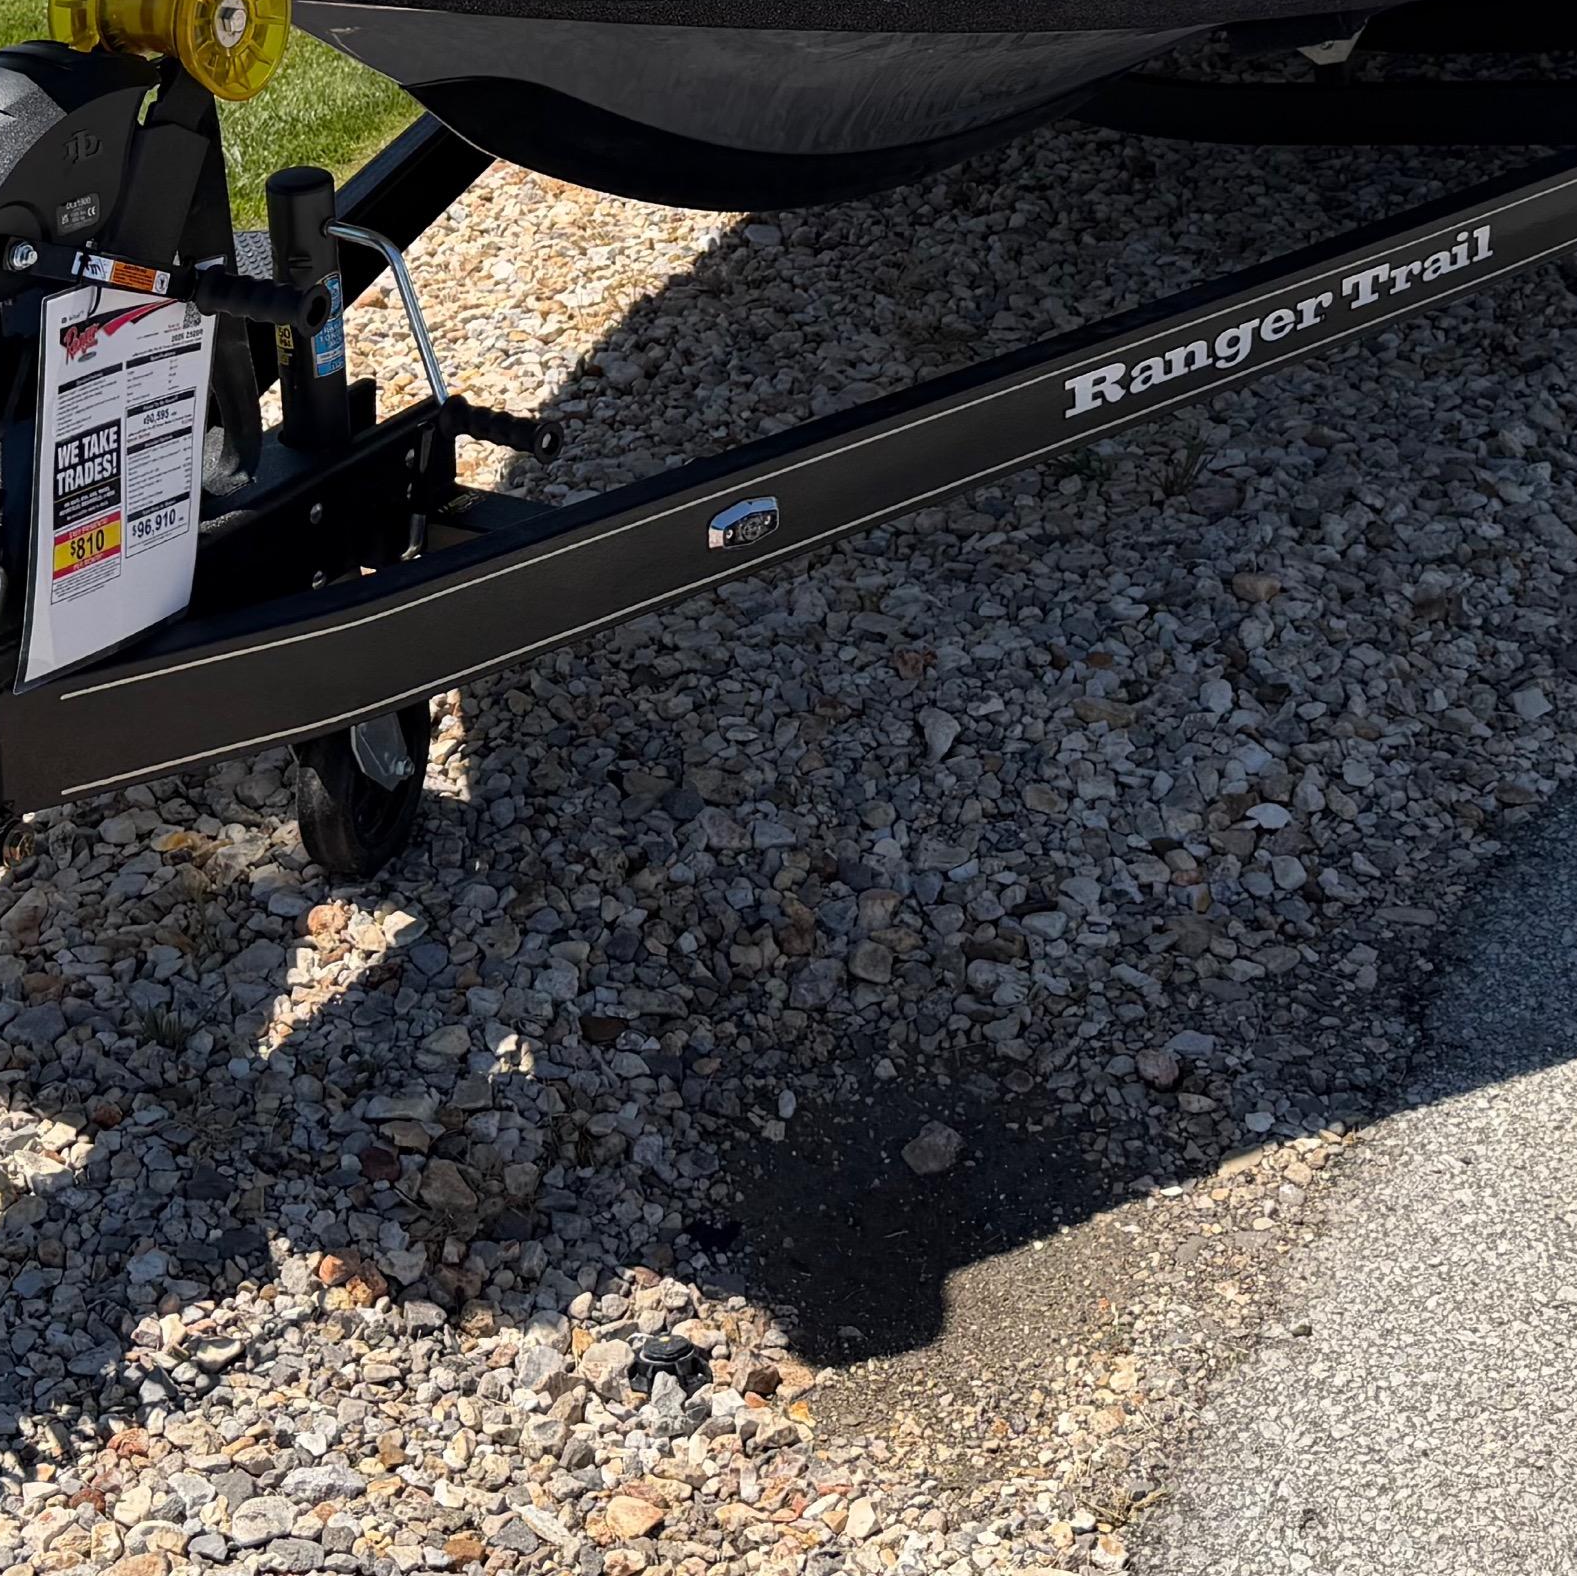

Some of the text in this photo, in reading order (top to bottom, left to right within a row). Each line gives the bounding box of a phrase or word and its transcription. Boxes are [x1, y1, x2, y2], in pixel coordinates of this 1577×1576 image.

[1064, 224, 1494, 419] Ranger Trail
[57, 442, 80, 470] WE
[82, 426, 118, 458] TAKE
[56, 452, 117, 496] TRADES!
[70, 529, 104, 560] $810
[132, 508, 176, 538] $96,910
